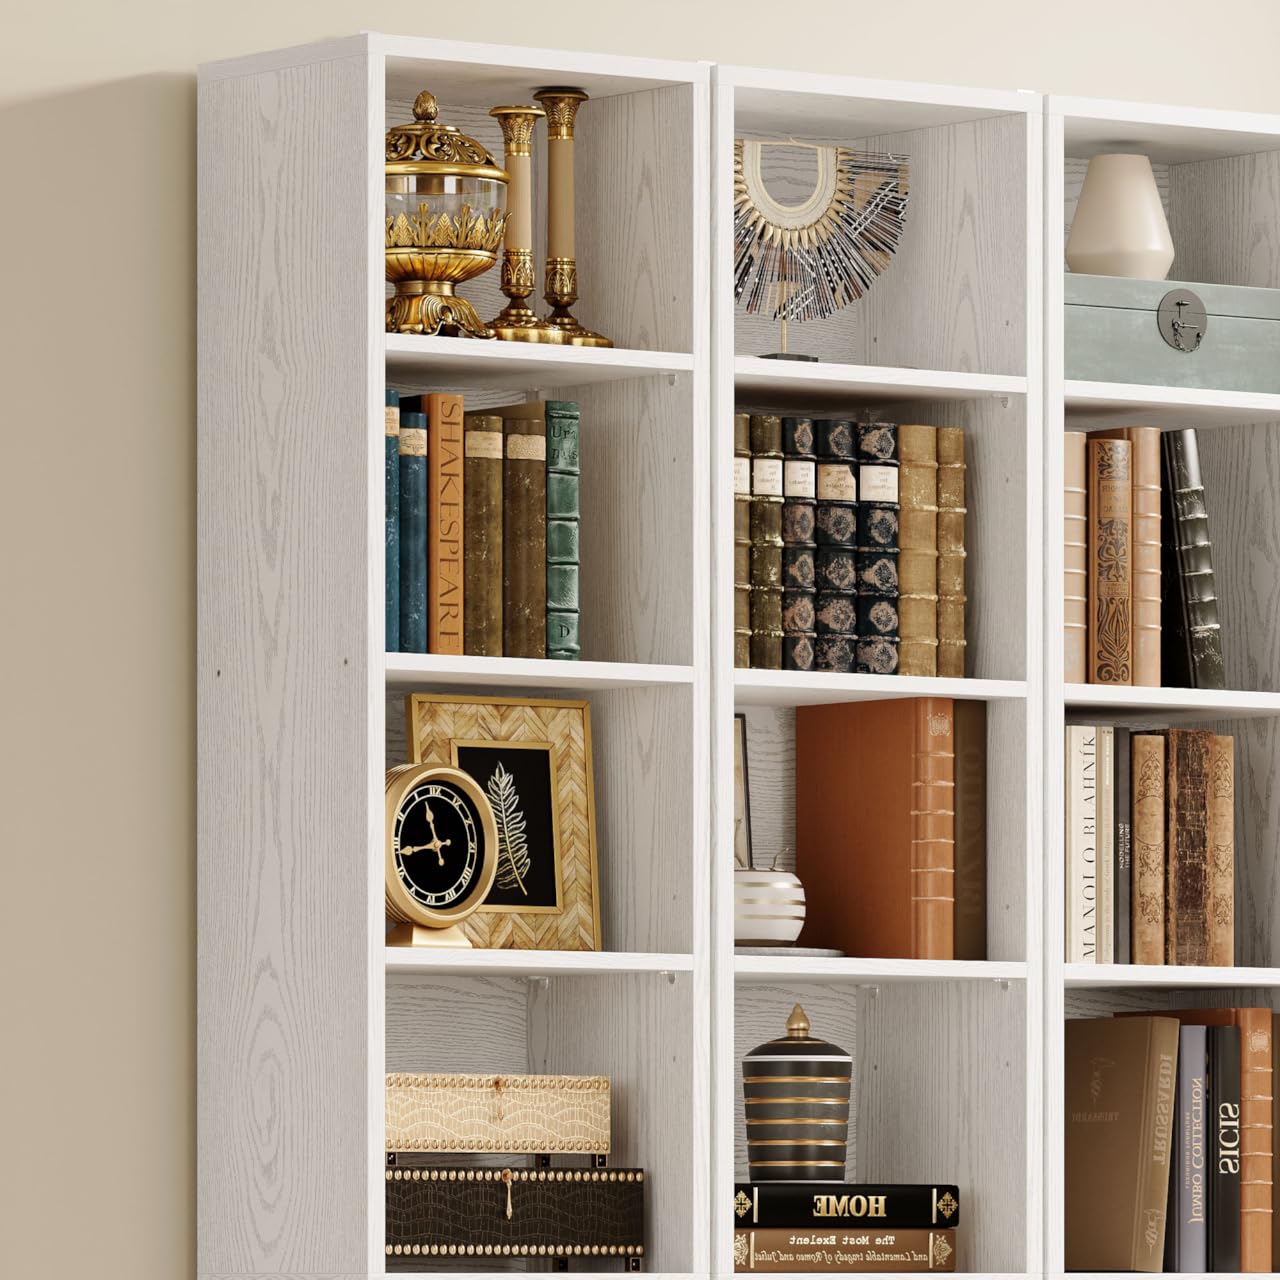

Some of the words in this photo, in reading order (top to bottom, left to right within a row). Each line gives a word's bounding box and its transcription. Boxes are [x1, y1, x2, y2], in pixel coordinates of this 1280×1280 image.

[439, 401, 461, 647] SHAKESPEARE
[559, 625, 570, 638] D
[1079, 736, 1096, 836] BLAHNÍK
[1082, 847, 1096, 960] MANOLO
